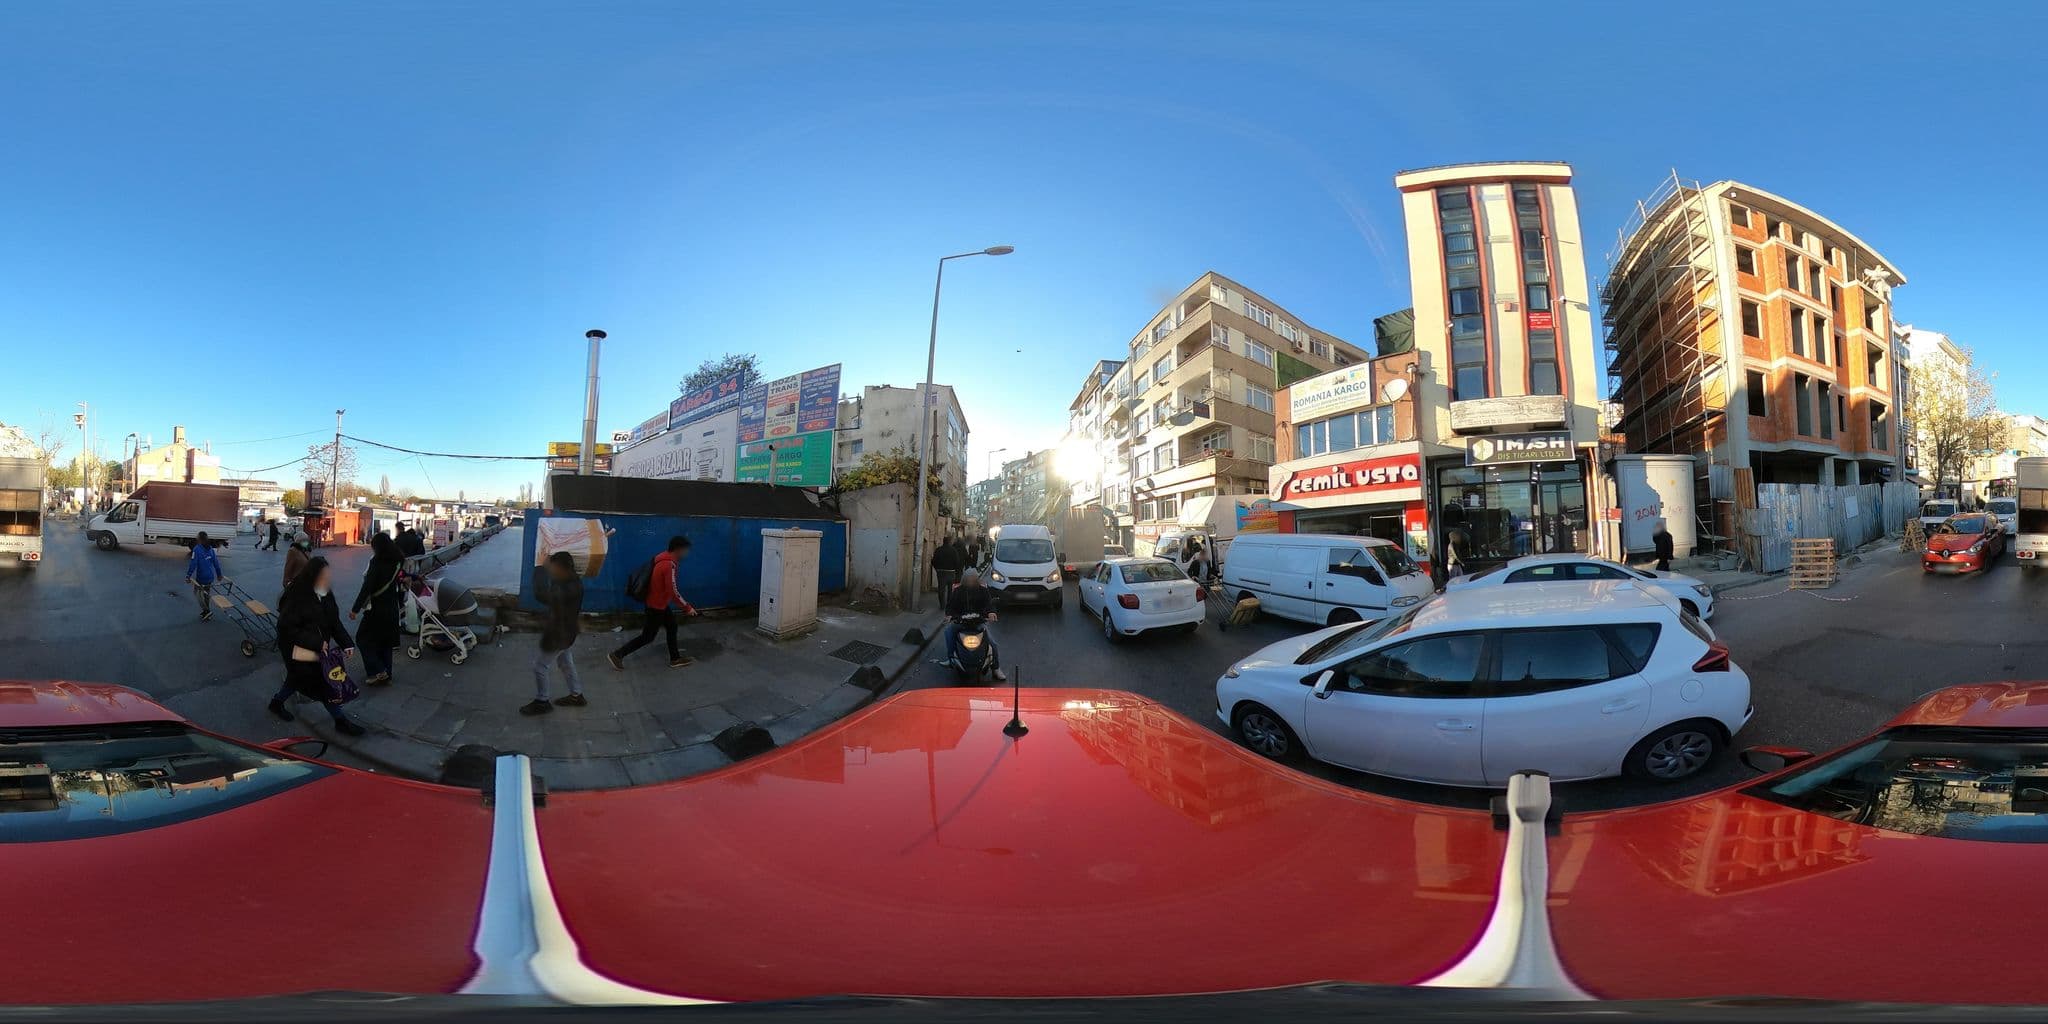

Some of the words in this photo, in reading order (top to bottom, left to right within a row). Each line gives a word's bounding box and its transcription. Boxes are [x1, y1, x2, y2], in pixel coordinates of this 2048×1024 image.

[672, 389, 713, 416] KARGO
[719, 378, 737, 396] 34
[770, 382, 799, 394] TRANS
[1293, 390, 1332, 408] ROMANIA
[1334, 381, 1367, 395] KARGO
[656, 447, 692, 476] BAZAAR
